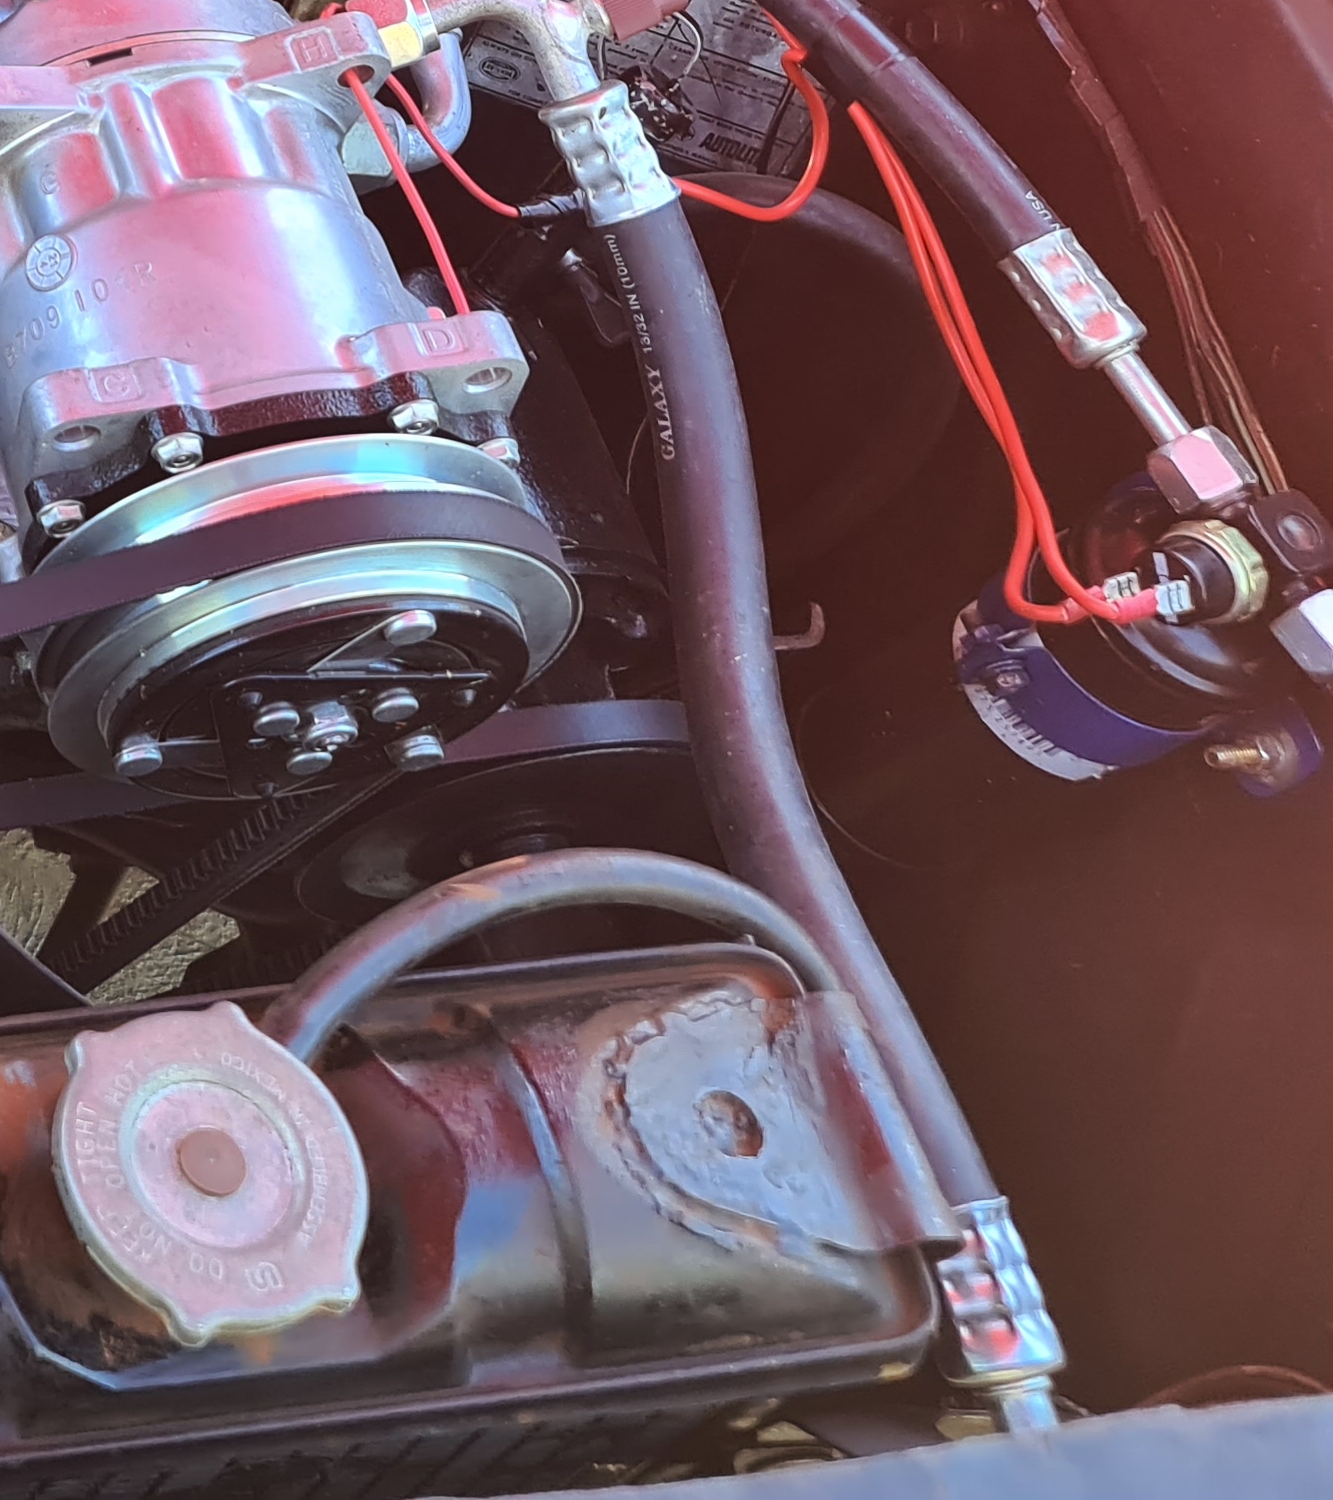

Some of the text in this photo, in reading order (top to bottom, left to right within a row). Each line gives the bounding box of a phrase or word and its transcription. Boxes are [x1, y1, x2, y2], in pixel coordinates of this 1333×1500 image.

[699, 131, 762, 165] AUTOLIT
[1025, 188, 1054, 219] USA
[603, 233, 676, 461] GALAXY 13/32 IN (10mm)
[104, 1060, 143, 1107] HOT
[219, 1050, 286, 1103] MEXICO
[75, 1101, 98, 1184] TIGHT
[96, 1119, 126, 1190] OPEN
[187, 1251, 225, 1281] DO
